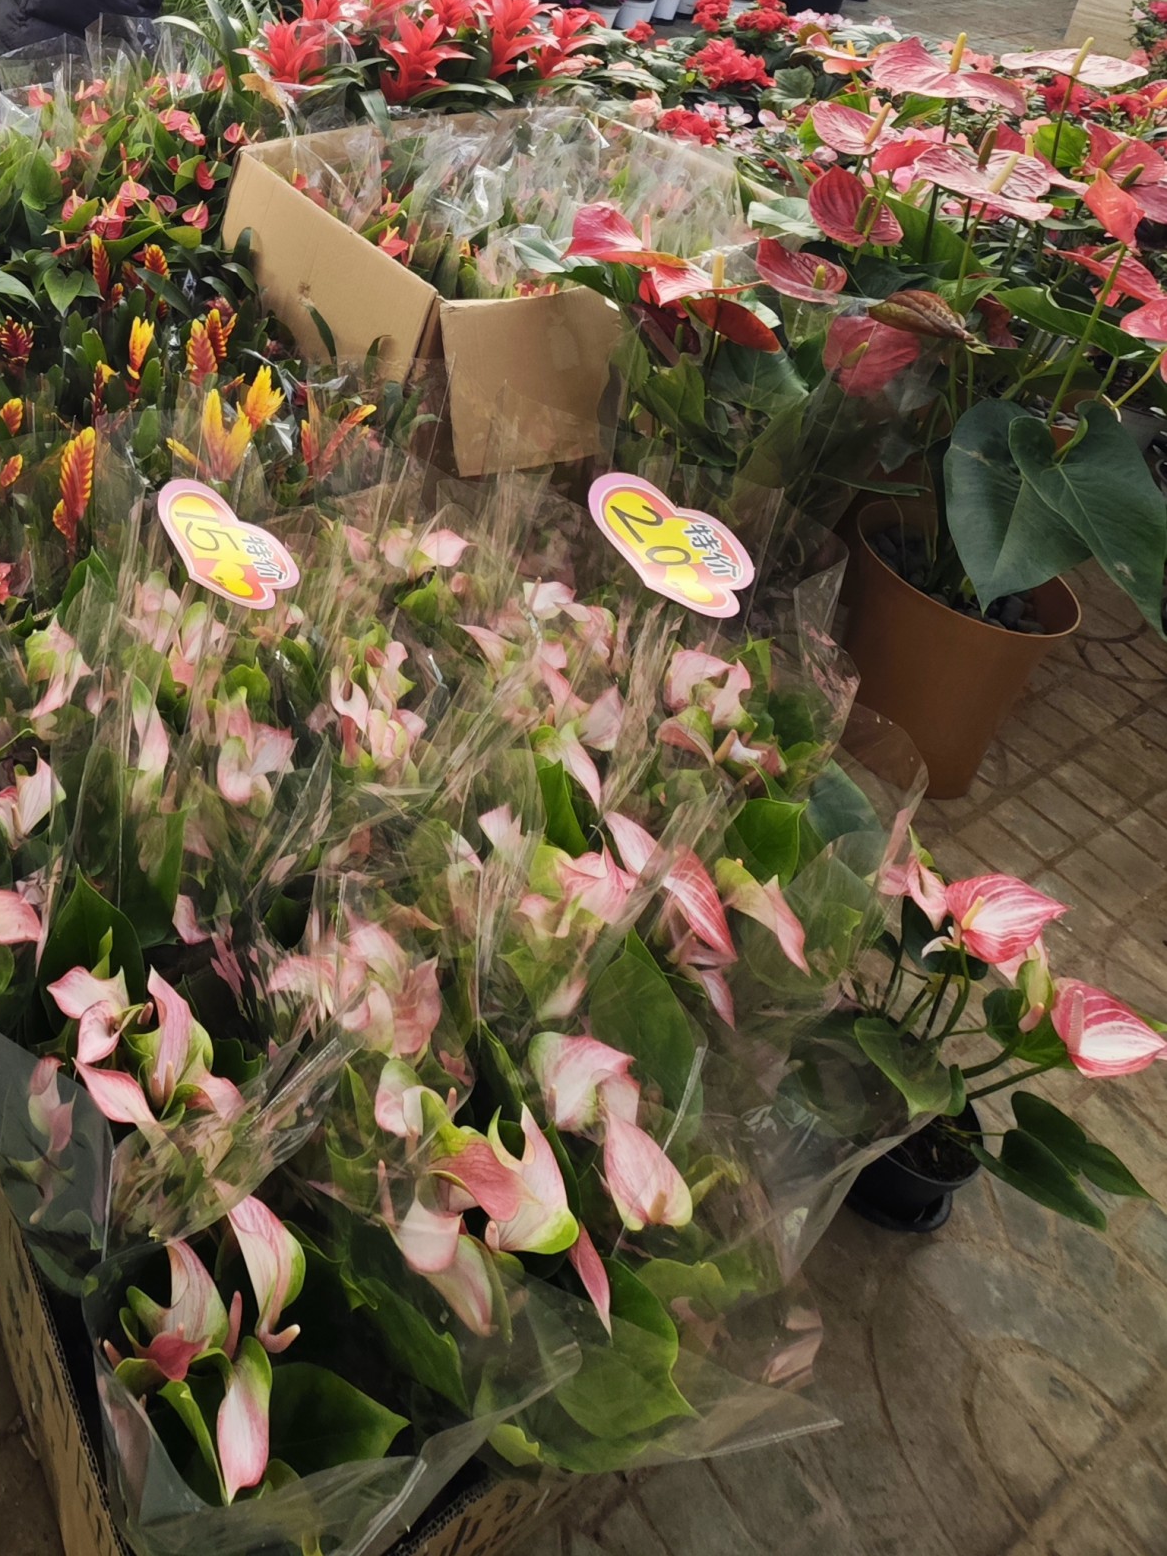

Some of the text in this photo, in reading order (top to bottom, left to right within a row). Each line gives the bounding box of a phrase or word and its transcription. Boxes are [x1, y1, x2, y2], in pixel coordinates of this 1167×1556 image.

[174, 511, 239, 551] 15
[610, 505, 692, 566] 20
[684, 524, 738, 578] 特价
[242, 535, 283, 580] 特价
